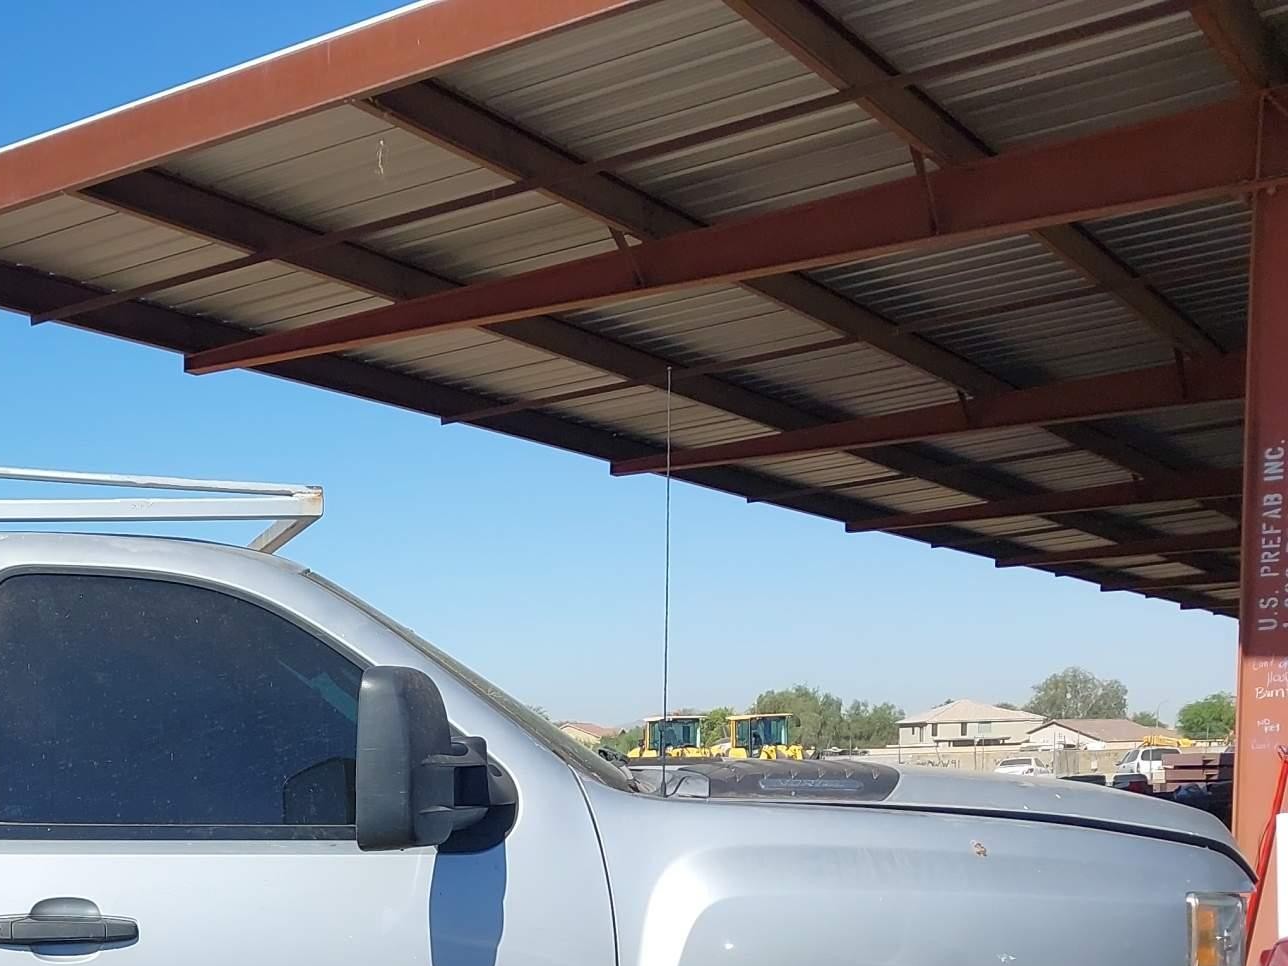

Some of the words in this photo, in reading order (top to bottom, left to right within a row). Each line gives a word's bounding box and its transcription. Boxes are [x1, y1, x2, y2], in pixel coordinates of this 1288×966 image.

[1263, 438, 1285, 482] INC.
[1260, 492, 1283, 577] PREFAB
[1258, 589, 1279, 631] U.S.
